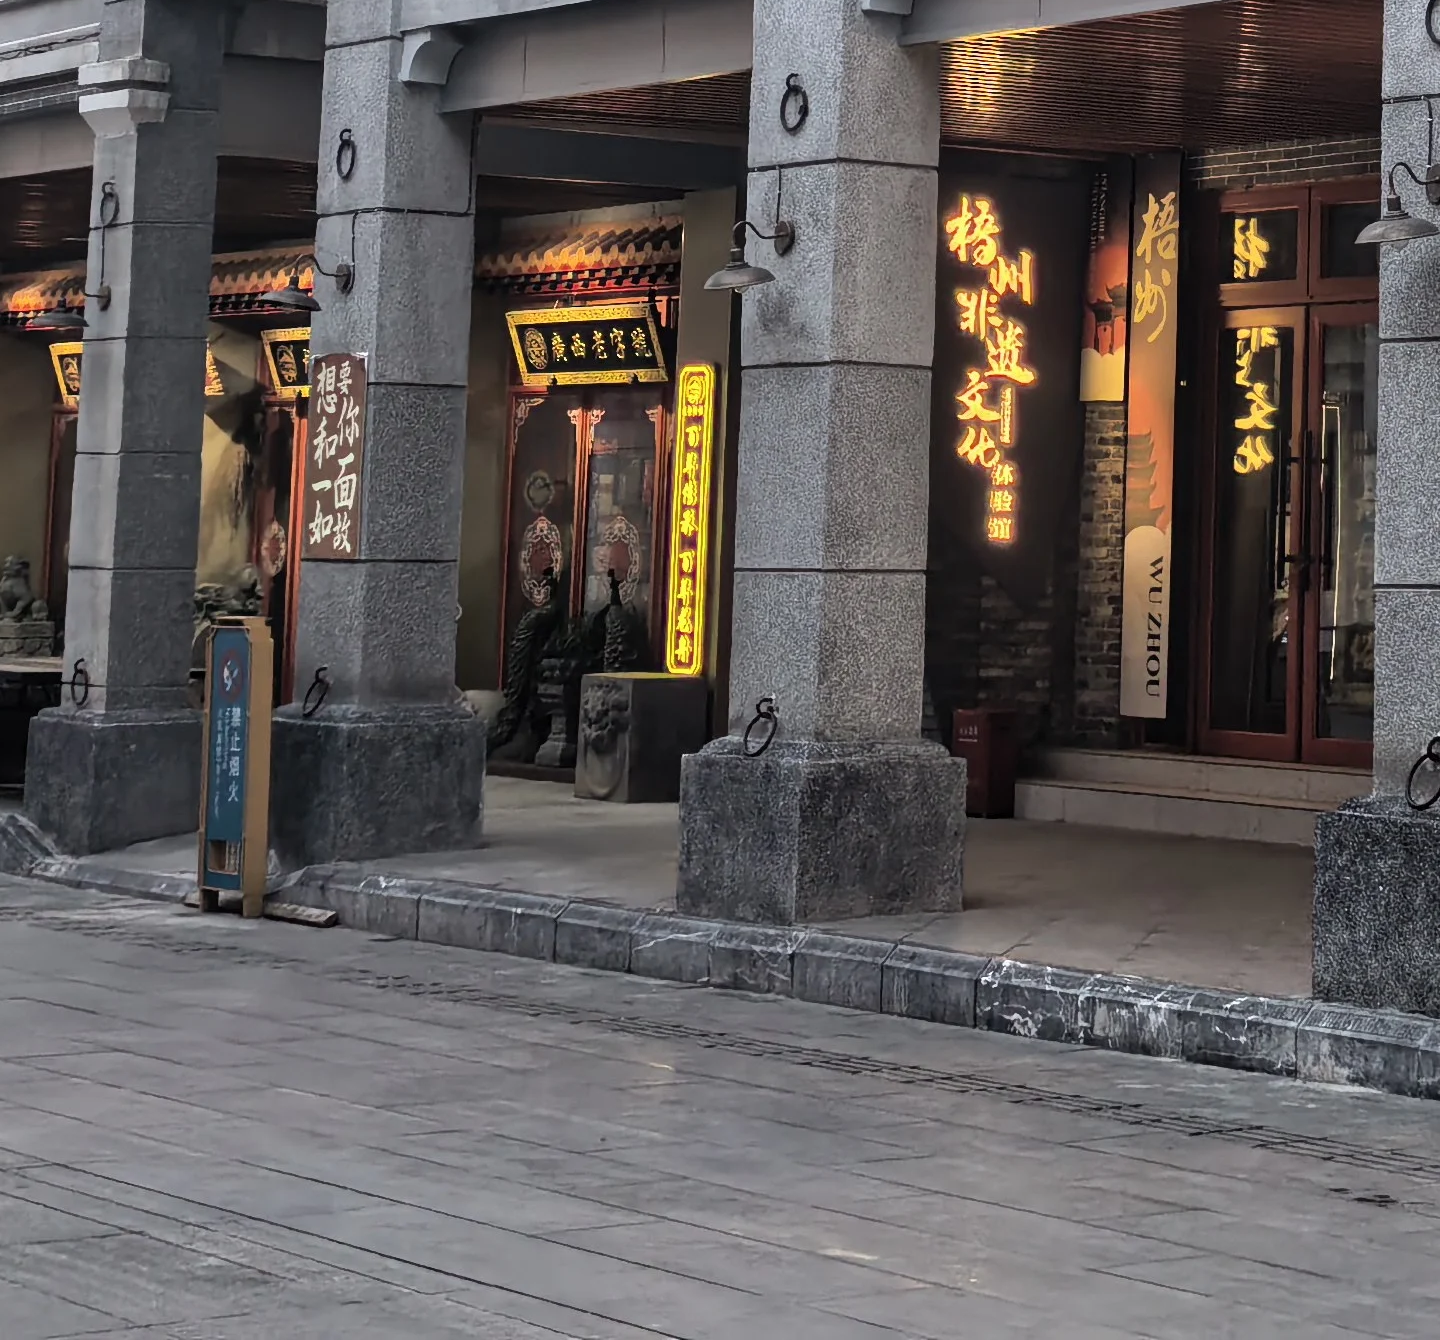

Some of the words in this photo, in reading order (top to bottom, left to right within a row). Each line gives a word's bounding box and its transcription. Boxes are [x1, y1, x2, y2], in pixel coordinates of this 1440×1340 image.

[1134, 191, 1179, 343] 梧州
[946, 197, 1035, 467] 梧州非遗文化
[1148, 555, 1164, 604] WU
[1146, 612, 1162, 697] ZHOU
